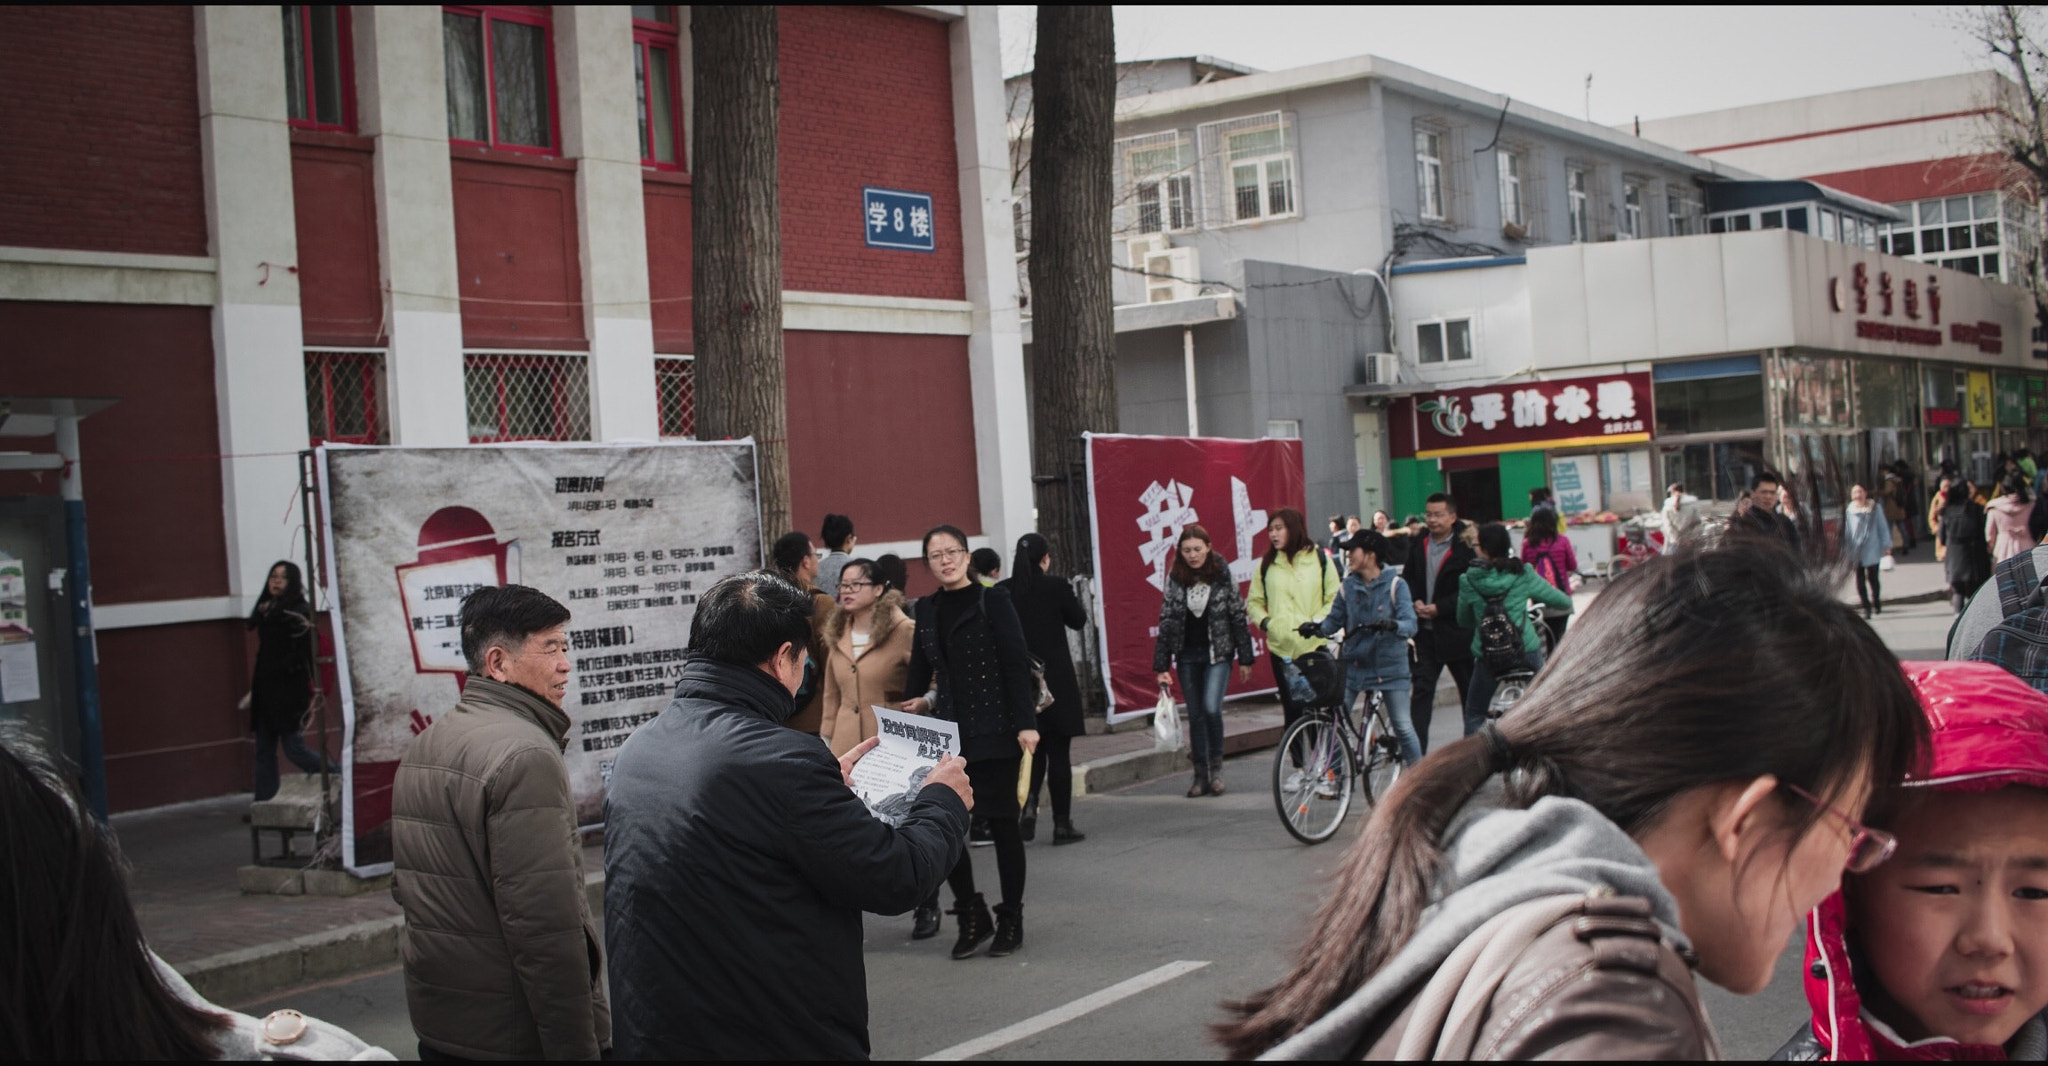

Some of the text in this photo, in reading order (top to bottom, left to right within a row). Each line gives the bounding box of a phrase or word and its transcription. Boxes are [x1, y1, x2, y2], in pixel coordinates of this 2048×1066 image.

[868, 201, 930, 238] 学8楼
[1469, 380, 1637, 431] 平价水果
[1603, 420, 1645, 435] 北师大店
[554, 475, 605, 494] 初赛时间
[551, 529, 601, 548] 报名方式
[567, 625, 634, 651] 特别福利】
[578, 664, 687, 688] 市大学生电影节主持人大
